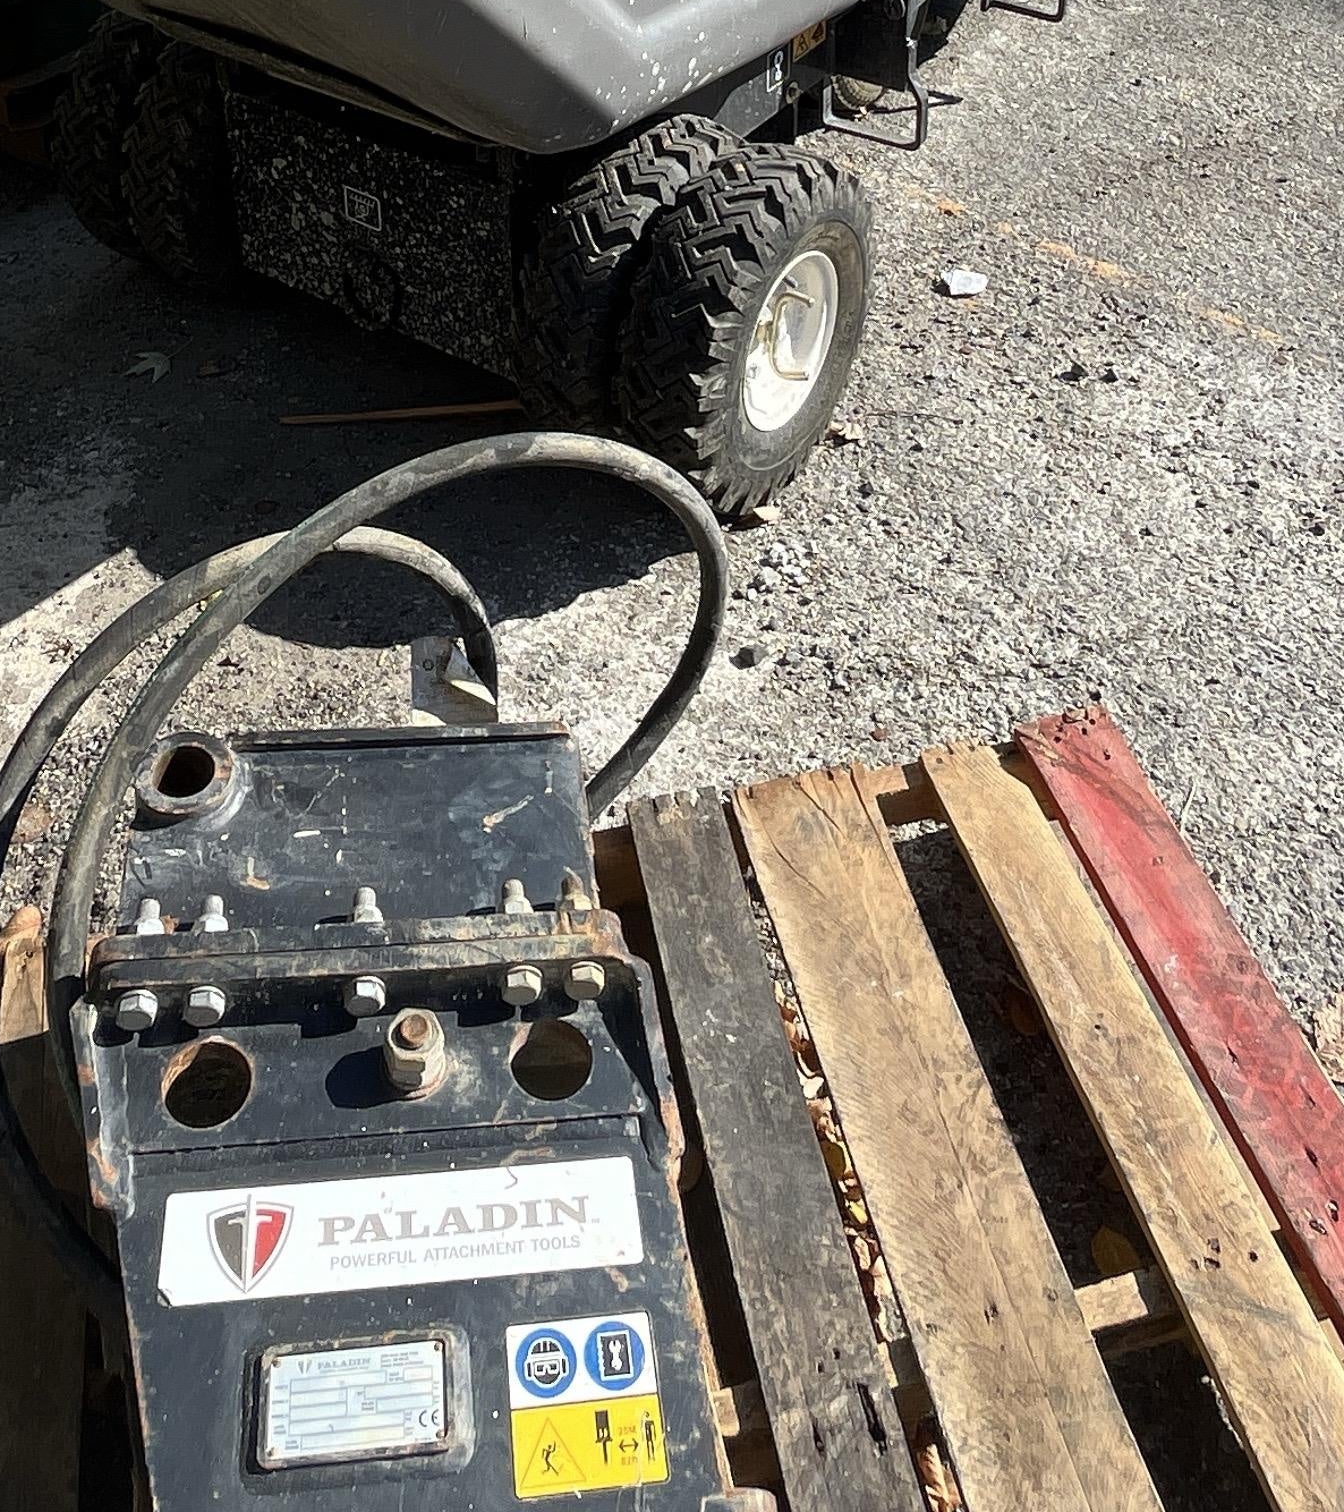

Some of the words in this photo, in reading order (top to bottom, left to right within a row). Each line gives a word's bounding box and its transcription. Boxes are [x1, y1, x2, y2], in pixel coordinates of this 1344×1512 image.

[318, 1195, 589, 1247] PALADIN
[330, 1250, 417, 1270] POWERFUL
[423, 1239, 526, 1263] ATTACHMENT
[532, 1234, 581, 1253] TOOLS
